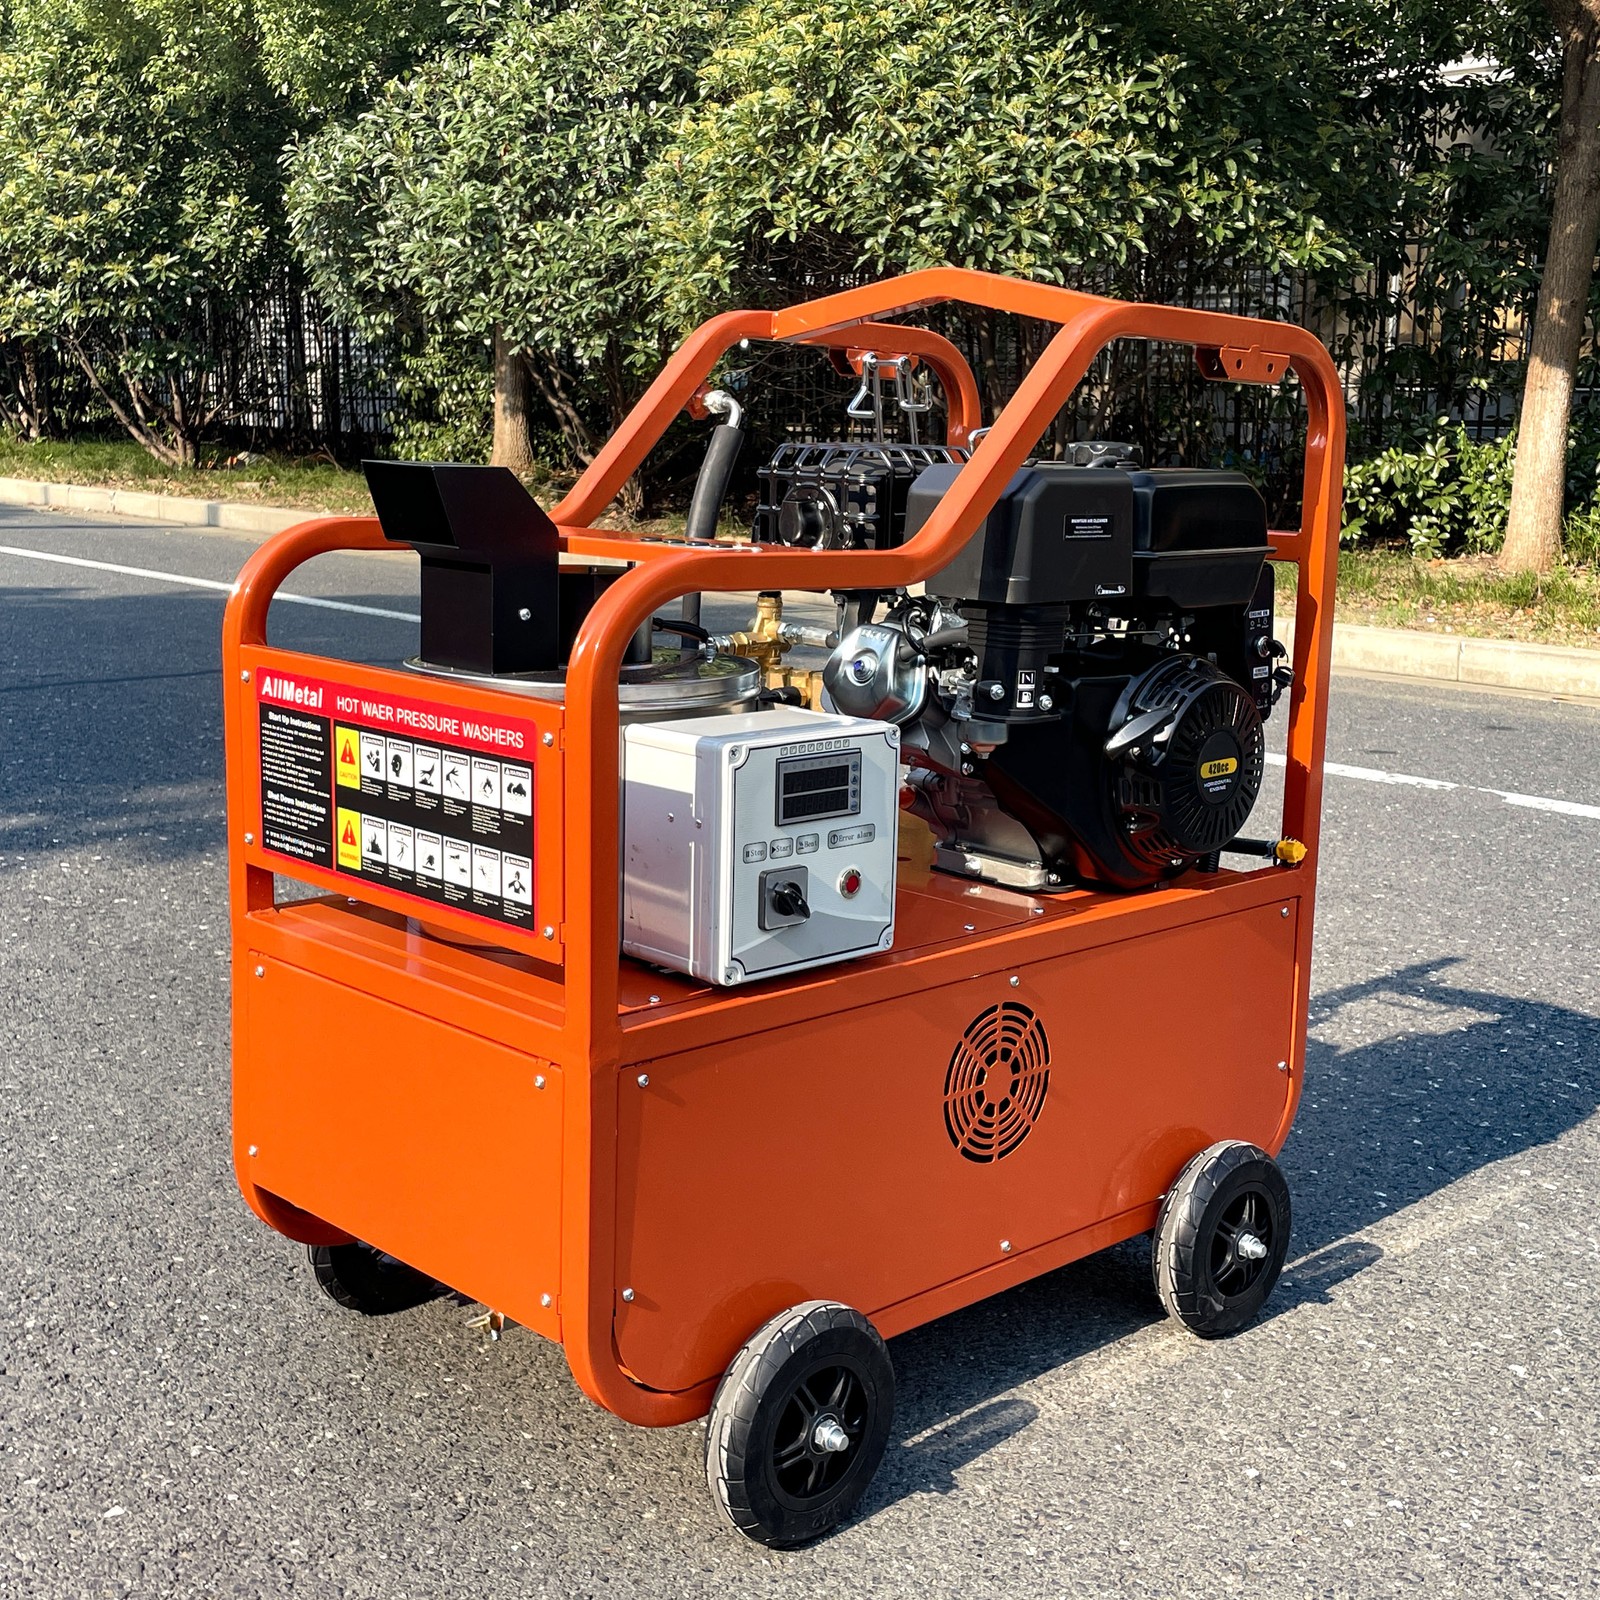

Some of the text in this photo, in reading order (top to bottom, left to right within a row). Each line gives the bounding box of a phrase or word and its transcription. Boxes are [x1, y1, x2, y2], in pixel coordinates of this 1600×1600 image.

[261, 676, 323, 708] AllMetal
[268, 711, 281, 722] Start
[281, 714, 290, 725] Up
[289, 716, 321, 732] Instructions
[336, 695, 524, 749] HOT WAER PRESSURE WASHERS
[1208, 762, 1229, 775] 420cc
[339, 770, 357, 780] CAUTION
[267, 790, 280, 801] Shut
[280, 793, 295, 805] Down
[294, 798, 326, 814] Instructions
[838, 830, 873, 842] Error alarm
[750, 848, 765, 858] Stop
[775, 844, 792, 853] Start
[340, 851, 359, 862] WARNING
